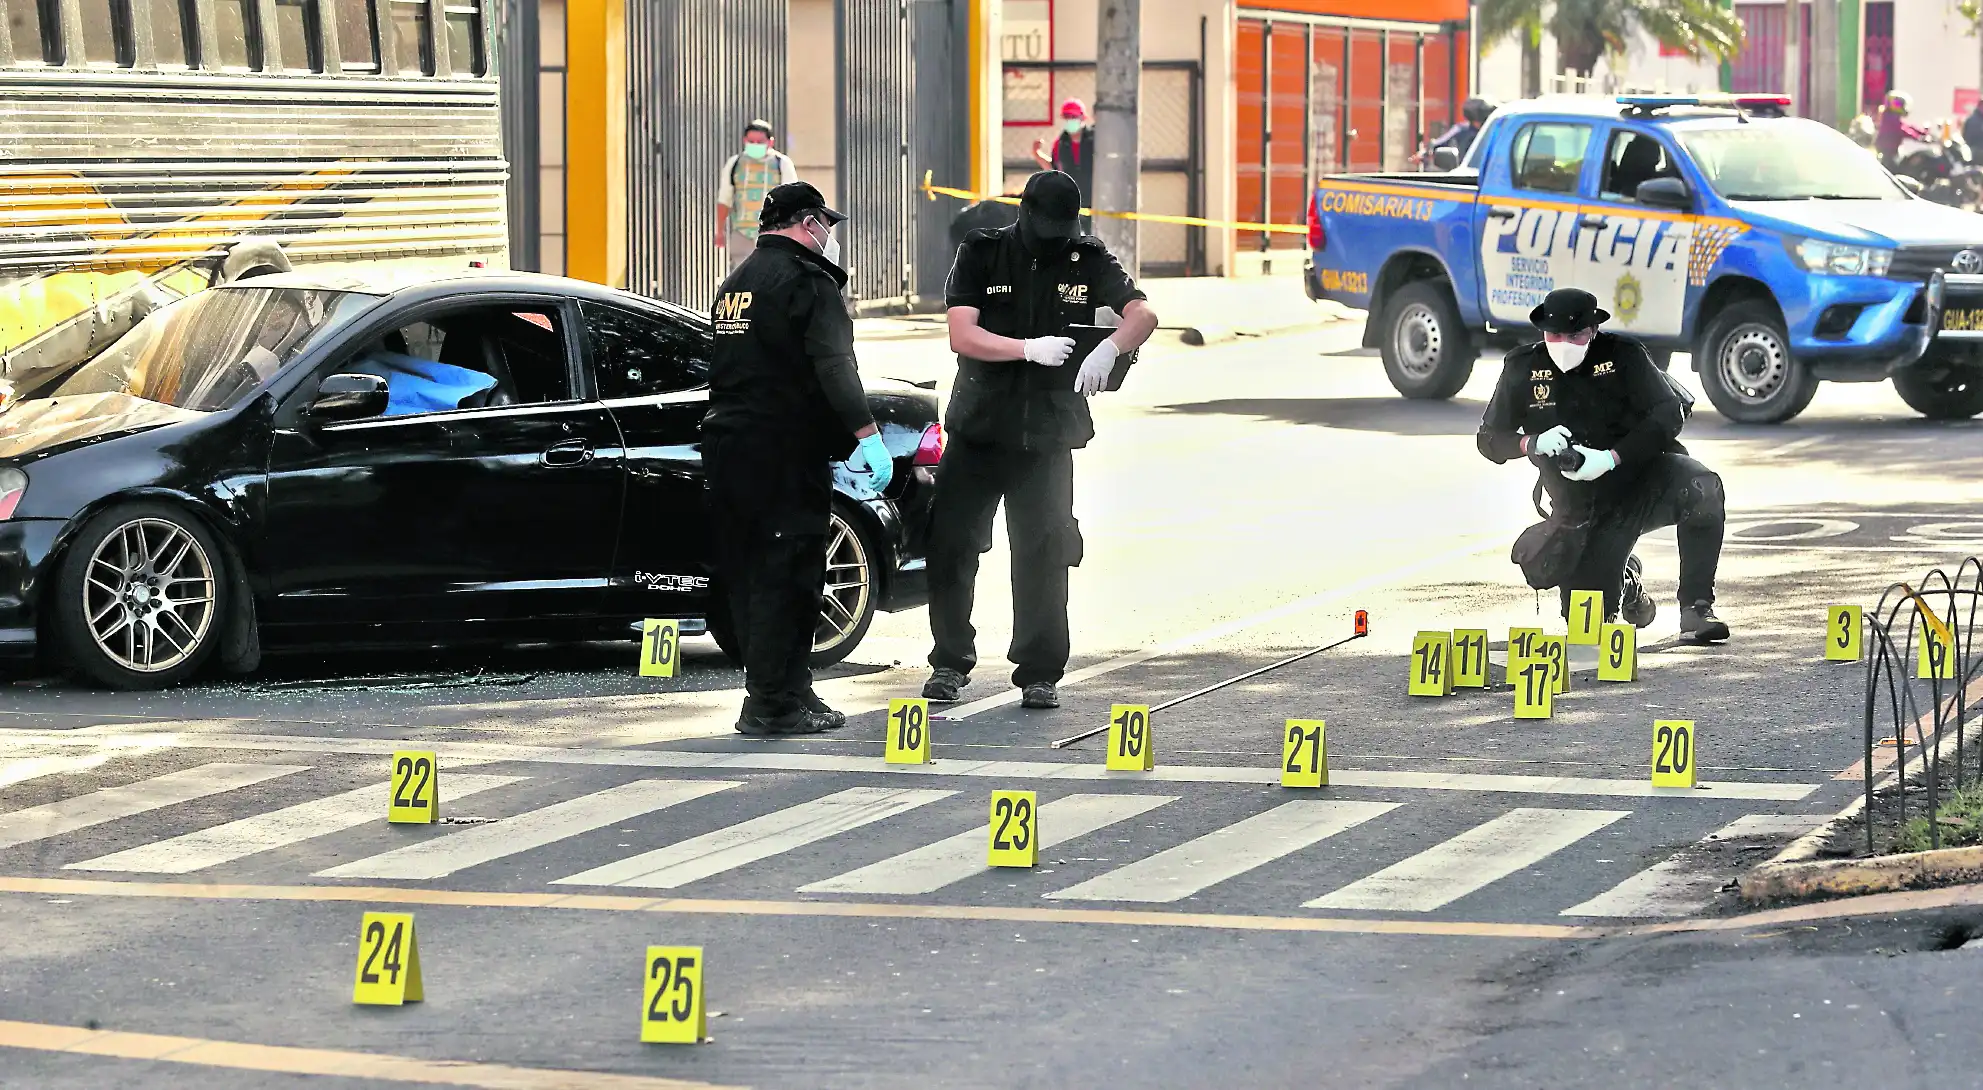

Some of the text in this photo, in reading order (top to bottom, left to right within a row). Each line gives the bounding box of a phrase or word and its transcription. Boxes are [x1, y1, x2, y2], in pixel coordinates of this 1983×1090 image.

[1000, 28, 1042, 60] TÚ
[1322, 191, 1434, 222] COMISARIA 13
[1506, 273, 1554, 291] INTEGRIDAD
[1511, 256, 1549, 274] SERVICIO
[719, 291, 753, 320] MP
[1531, 369, 1552, 378] MP
[1593, 361, 1614, 374] MP
[647, 583, 693, 592] DOHC
[1579, 596, 1593, 634] 1
[1837, 610, 1851, 649] 3
[646, 624, 674, 665] 16
[1415, 642, 1442, 685] 14
[1455, 634, 1484, 676] 11
[1609, 629, 1625, 669] 9
[1930, 628, 1943, 668] 6
[1519, 663, 1549, 706] 17
[892, 704, 923, 751] 18
[1113, 710, 1144, 757] 19
[1286, 725, 1321, 774] 21
[1655, 726, 1689, 774] 20
[393, 757, 431, 808] 22
[993, 797, 1031, 851] 23
[361, 921, 403, 985] 24
[648, 957, 695, 1022] 25
